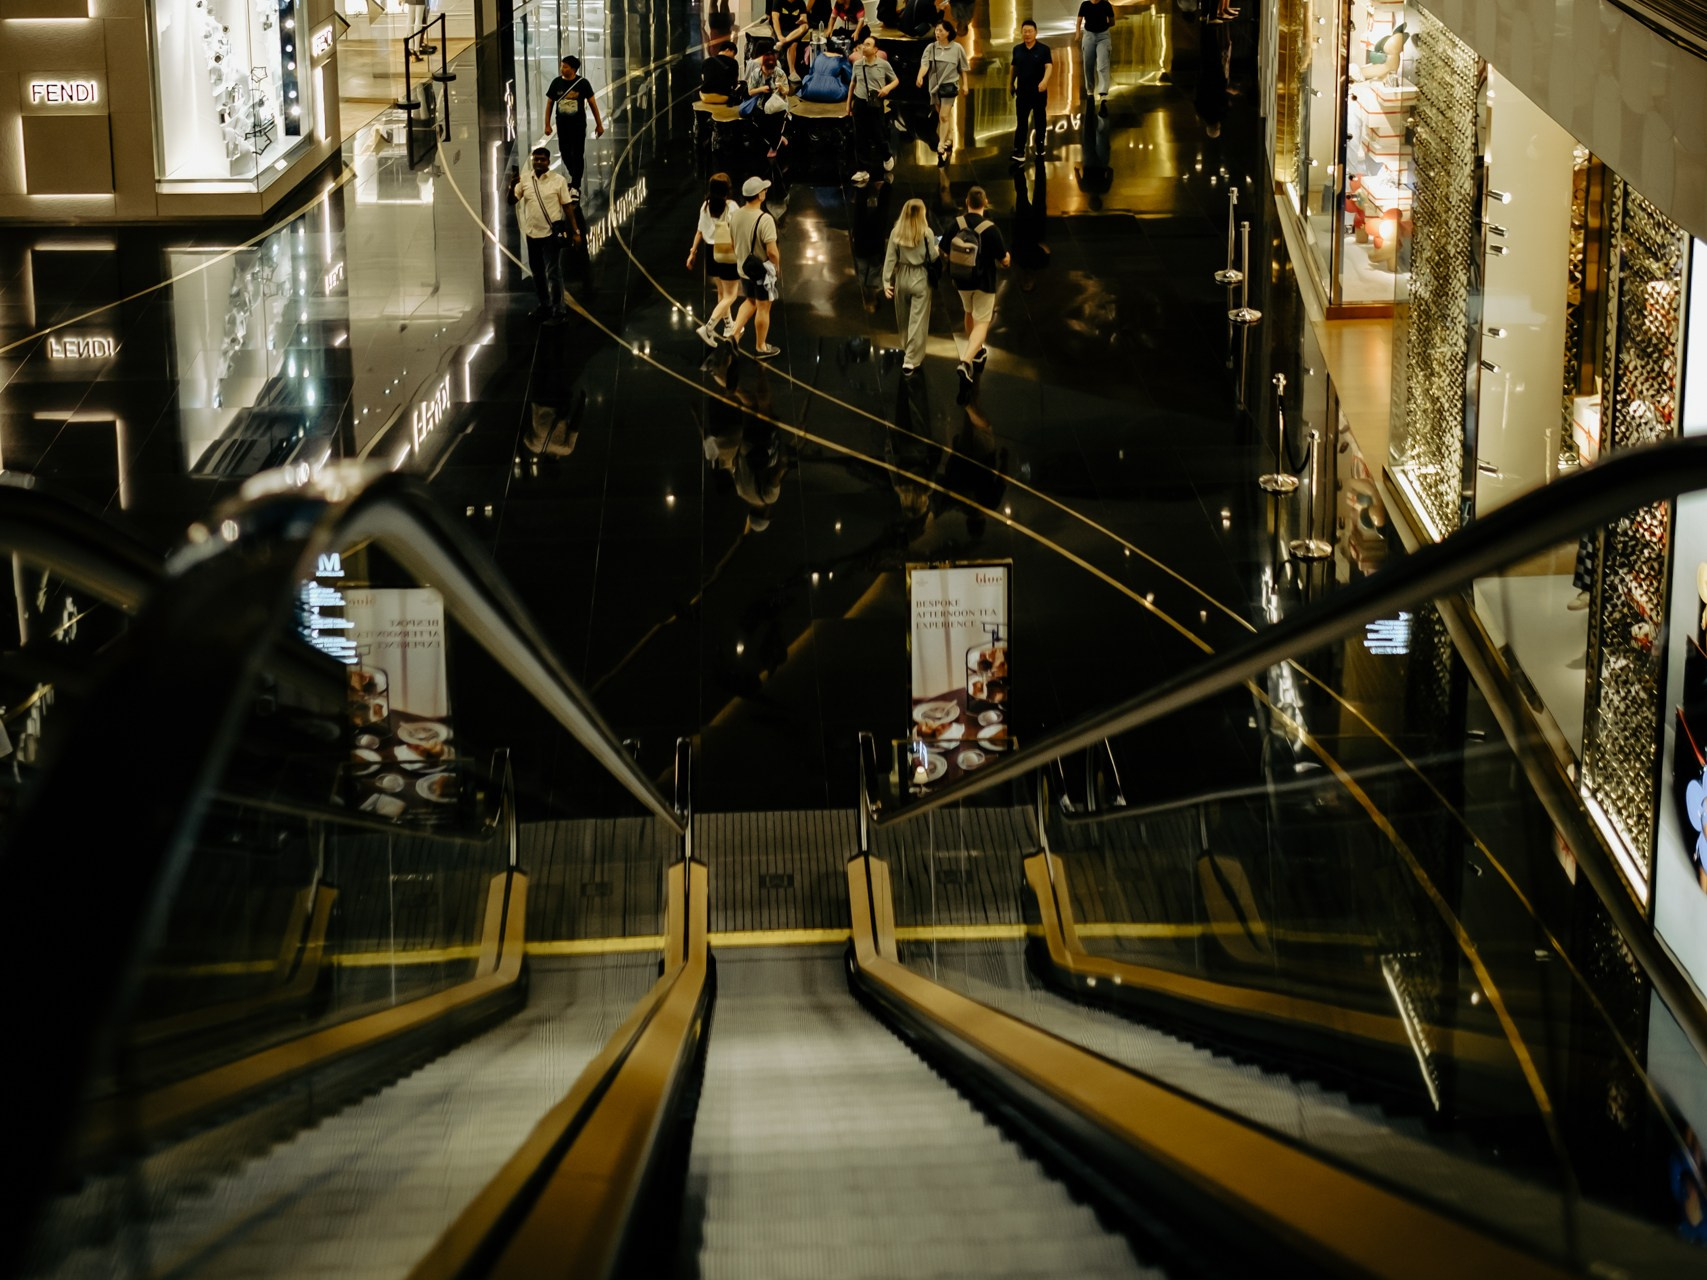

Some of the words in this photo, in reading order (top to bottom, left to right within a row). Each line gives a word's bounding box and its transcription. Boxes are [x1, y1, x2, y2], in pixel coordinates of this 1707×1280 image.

[31, 83, 95, 102] FENDI
[916, 600, 959, 608] BESPOKE
[916, 609, 975, 618] AFTERNOON
[979, 608, 997, 616] TEA
[916, 621, 975, 629] EXPERIENCE
